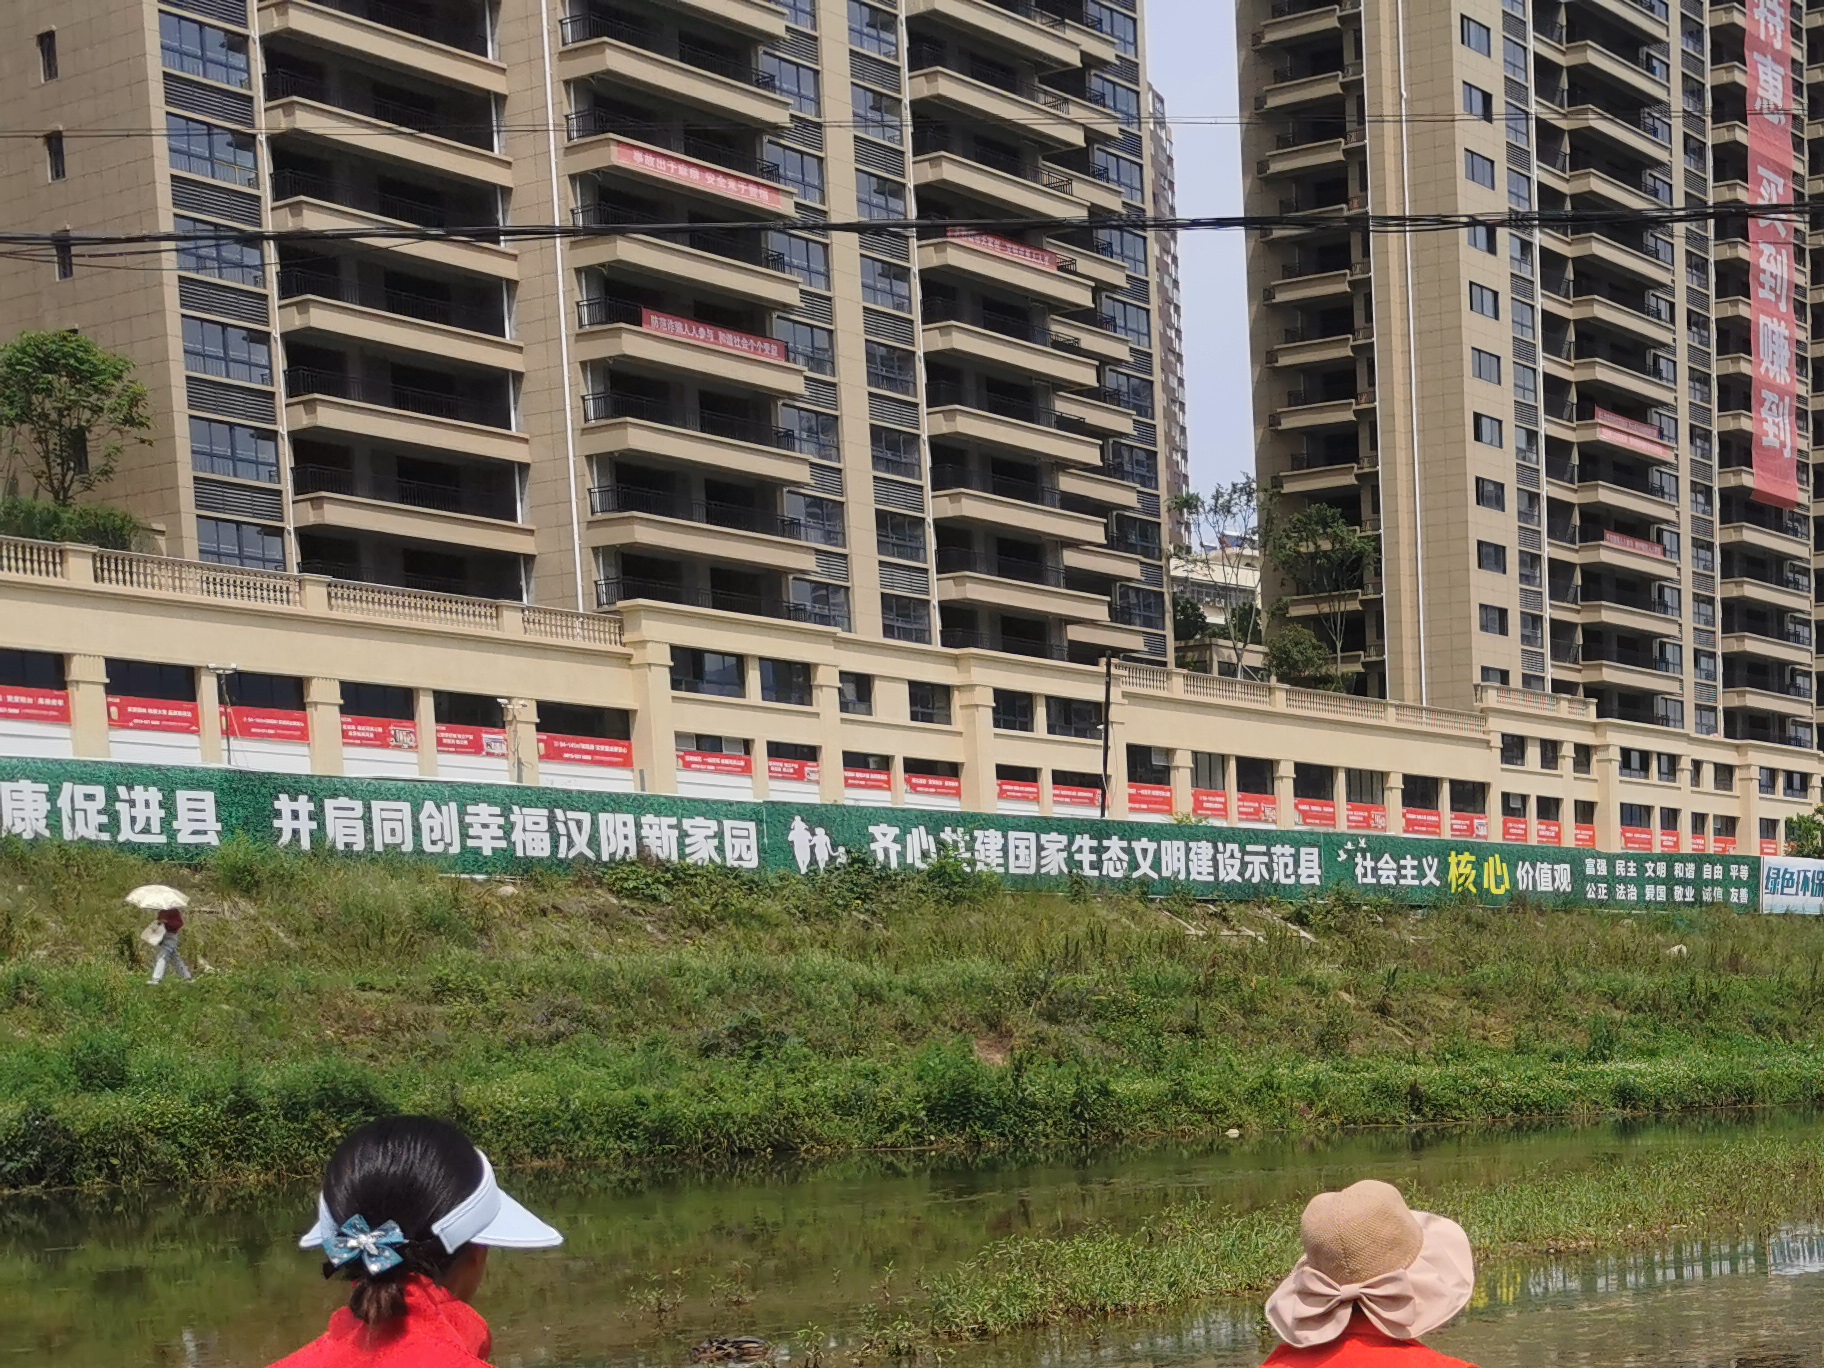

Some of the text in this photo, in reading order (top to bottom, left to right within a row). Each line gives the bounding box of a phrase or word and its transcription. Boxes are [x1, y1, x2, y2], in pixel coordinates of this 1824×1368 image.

[273, 794, 759, 869] 并肩同创幸福汉阴新家园
[1354, 851, 1572, 895] 社会主义 核心 价值观
[1585, 858, 1750, 881] 富强 民主 文明 和谐 自由 平等
[1586, 883, 1749, 904] 公正 法治 爱国 敬业 诚信 友善
